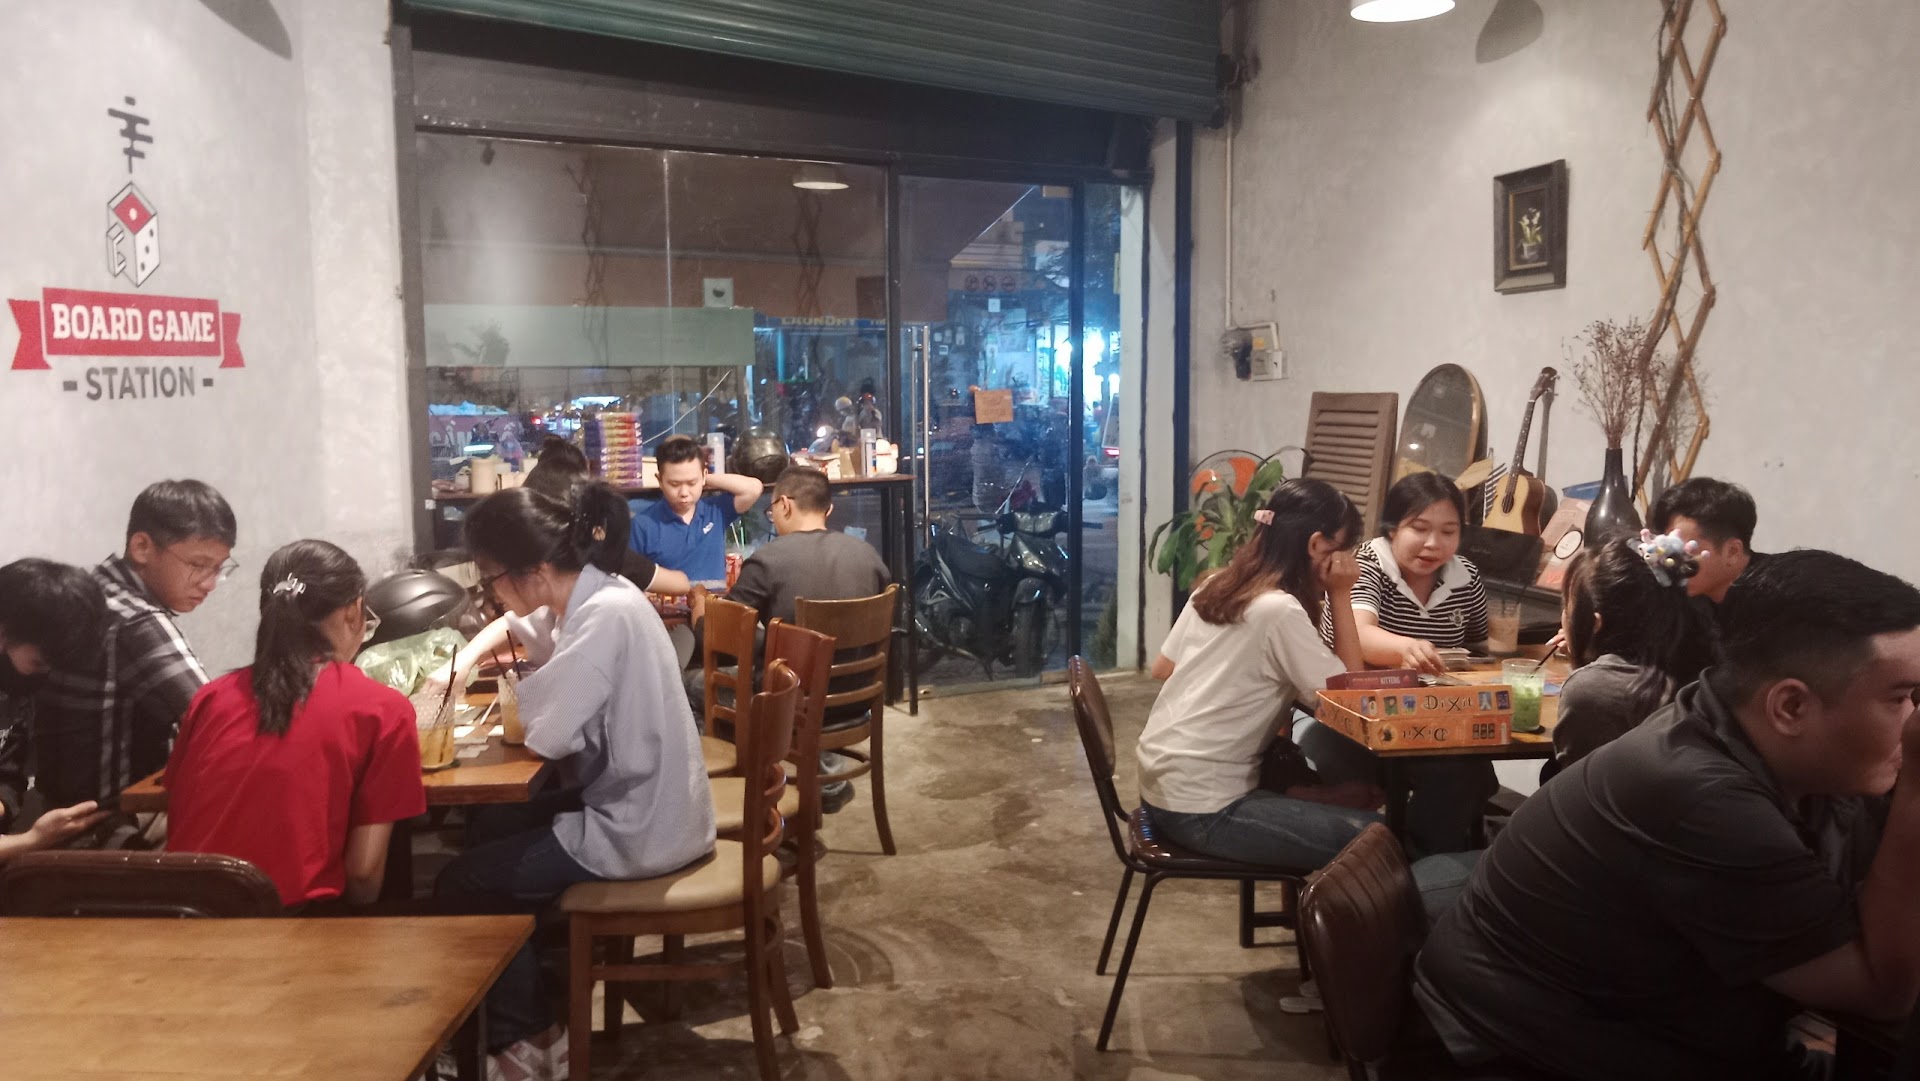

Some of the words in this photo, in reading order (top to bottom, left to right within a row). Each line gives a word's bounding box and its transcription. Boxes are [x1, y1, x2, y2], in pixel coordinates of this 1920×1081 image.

[51, 303, 144, 341] BOARD
[148, 309, 216, 343] GAME
[781, 316, 856, 326] LAUNDRY
[86, 366, 196, 400] STATION
